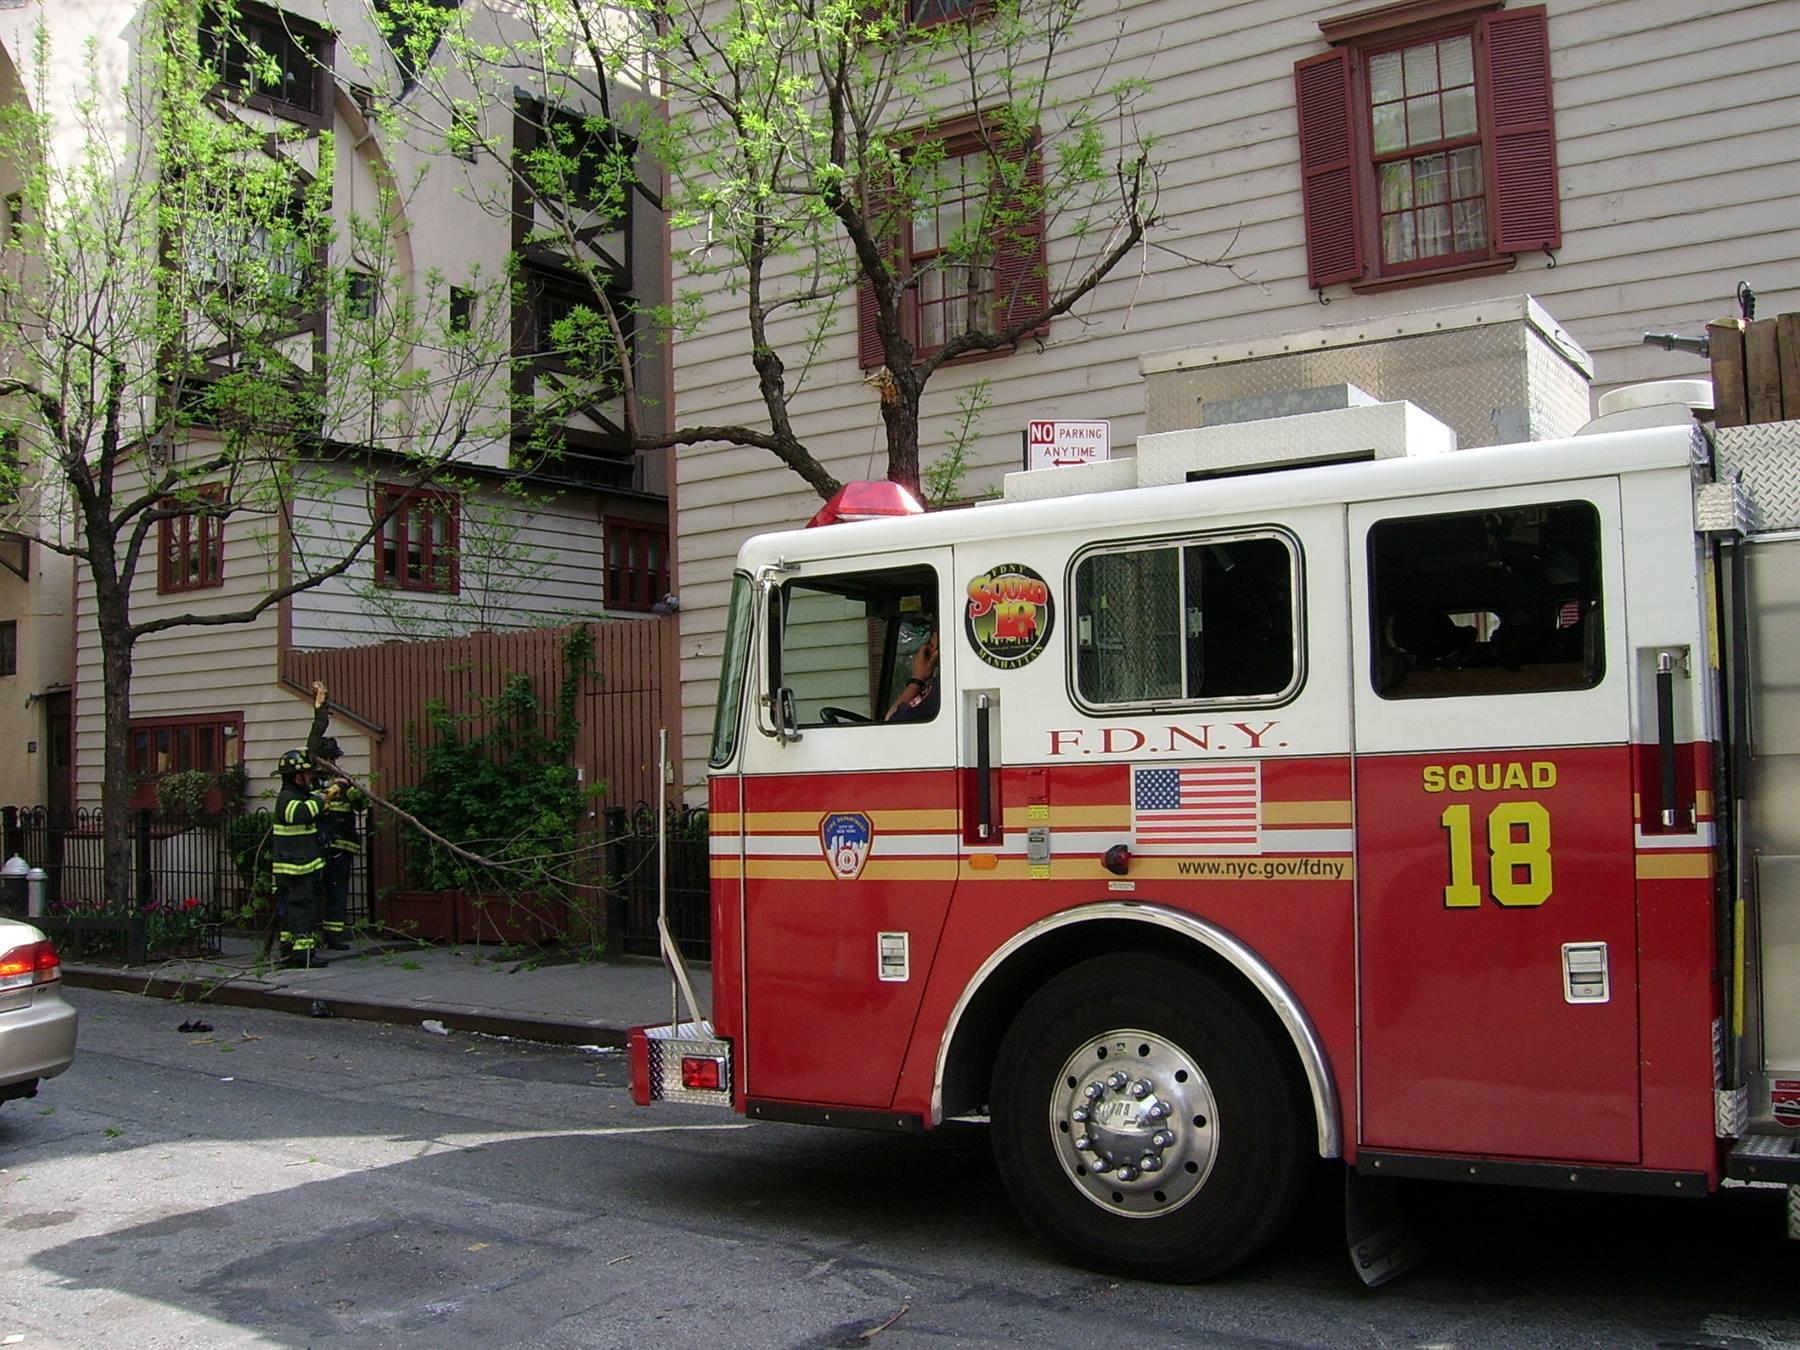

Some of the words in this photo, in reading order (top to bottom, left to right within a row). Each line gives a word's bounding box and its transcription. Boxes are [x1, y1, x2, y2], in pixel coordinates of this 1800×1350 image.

[1031, 424, 1053, 441] NO
[1060, 428, 1102, 439] PARKING
[1044, 447, 1096, 457] ANYTIME
[991, 565, 1026, 577] FDNY
[992, 600, 1037, 639] 18
[978, 645, 1043, 669] MANHATTAN
[1046, 721, 1288, 755] F.D.N.Y.
[1423, 761, 1557, 792] SQUAD
[1440, 801, 1553, 908] 18
[1177, 859, 1345, 879] www.nyc.gov/fdny
